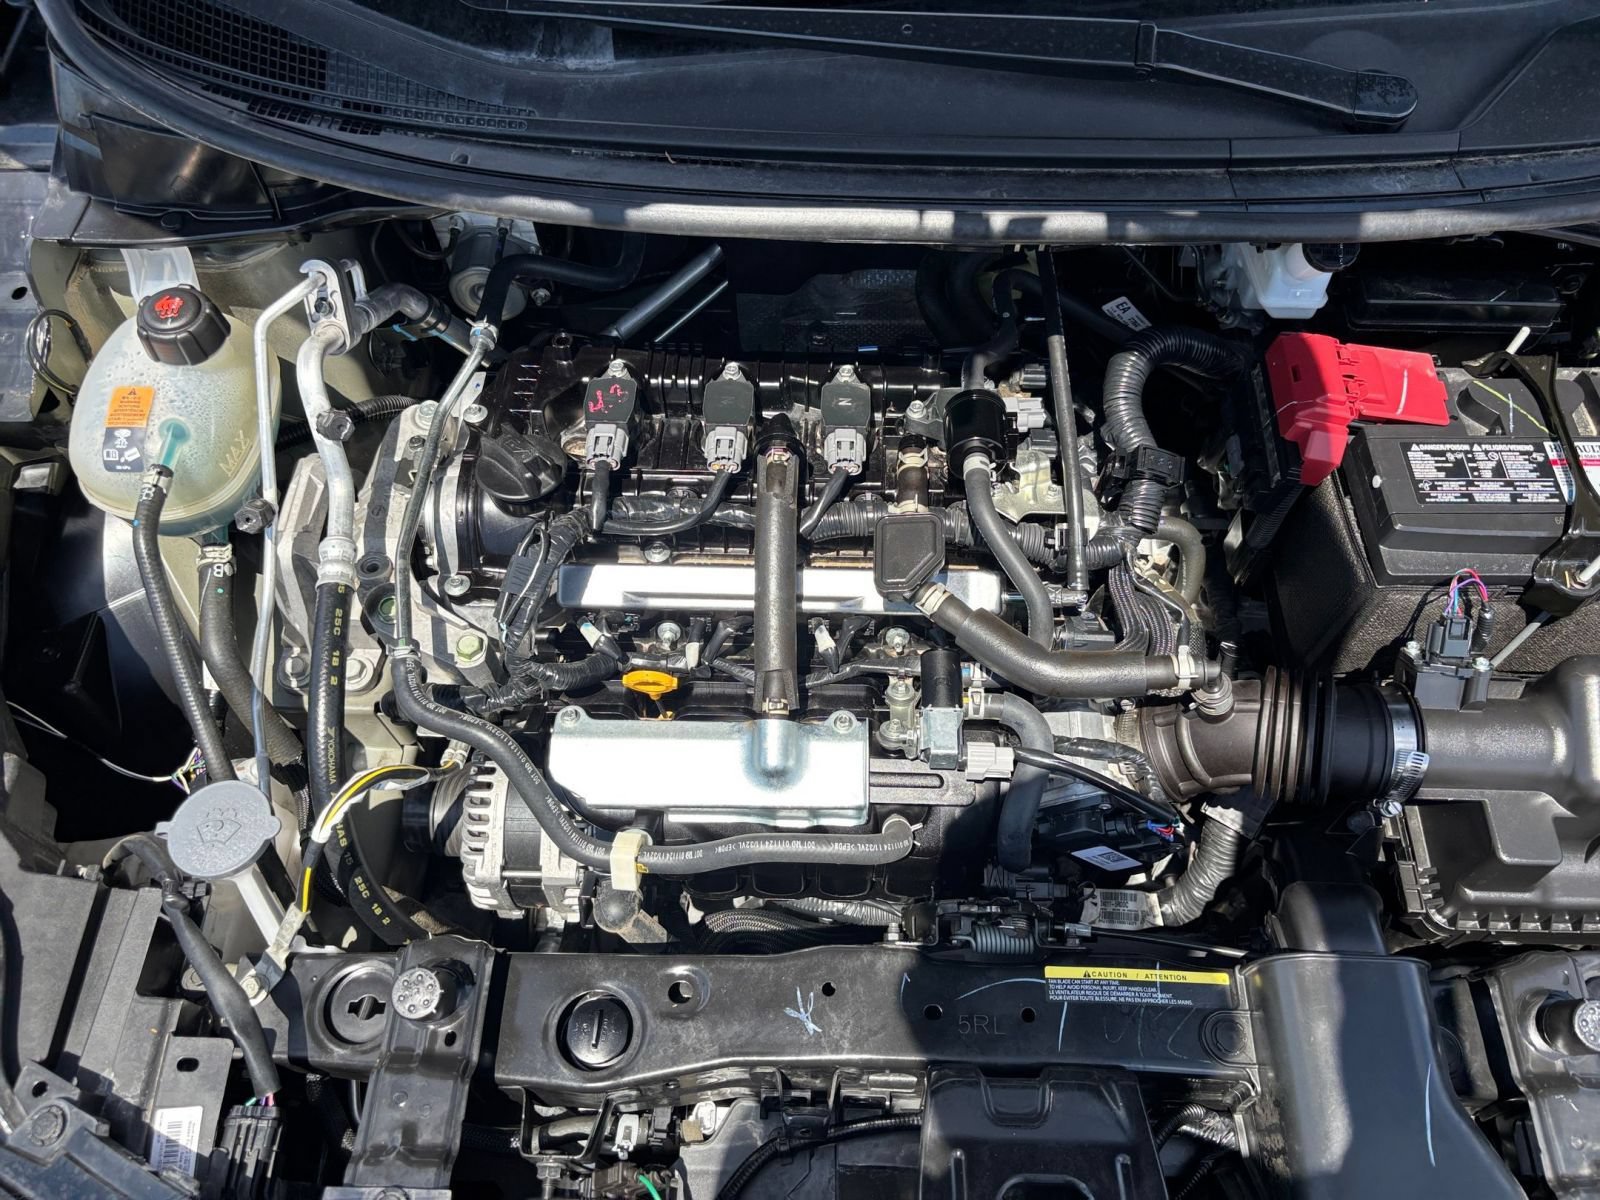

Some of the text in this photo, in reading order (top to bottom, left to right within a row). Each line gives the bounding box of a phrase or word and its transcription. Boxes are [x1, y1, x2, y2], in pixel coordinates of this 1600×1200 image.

[219, 429, 250, 477] MAX
[333, 608, 343, 636] 25C
[328, 738, 339, 785] YOKOHAMA
[354, 876, 370, 898] 25C
[1145, 973, 1187, 981] ATTENTION
[958, 1014, 1006, 1035] 5RL
